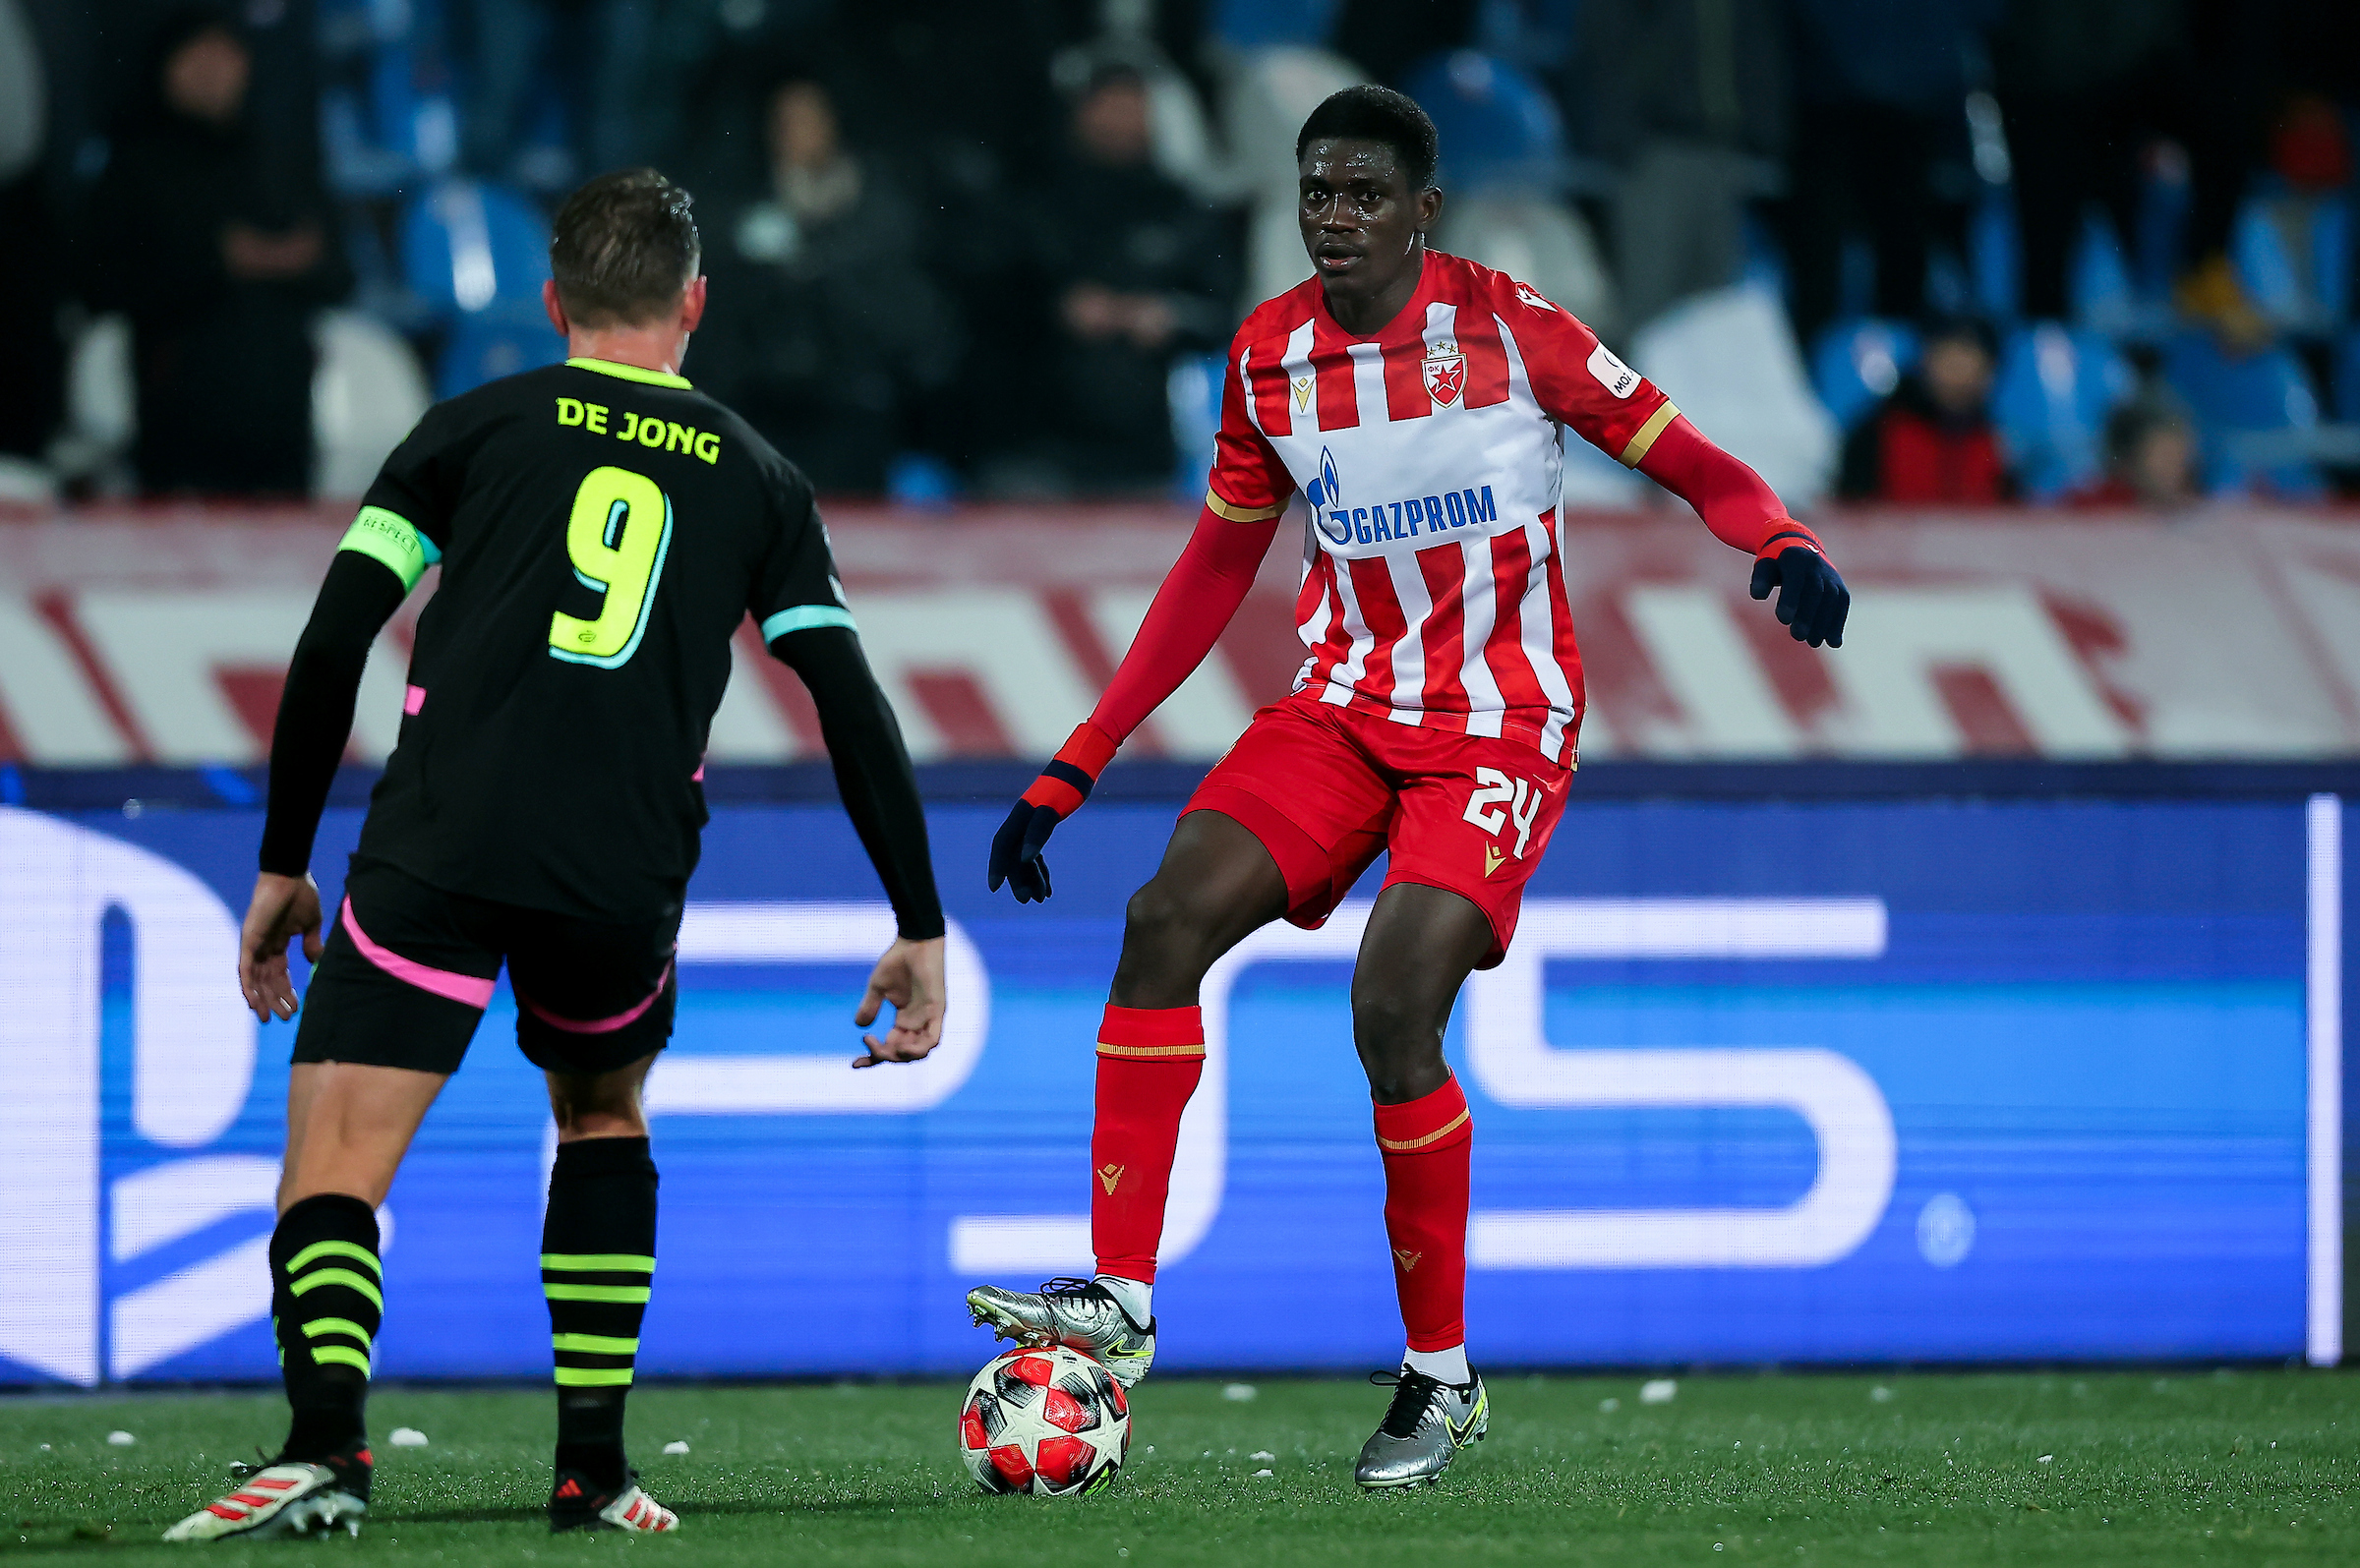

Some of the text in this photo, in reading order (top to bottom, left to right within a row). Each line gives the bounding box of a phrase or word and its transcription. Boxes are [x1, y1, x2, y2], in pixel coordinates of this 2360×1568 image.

[556, 396, 722, 466] DE JONG
[1352, 485, 1498, 545] GAZPROM
[548, 465, 674, 669] 9
[1462, 766, 1543, 861] 24
[542, 897, 1896, 1269] PS5
